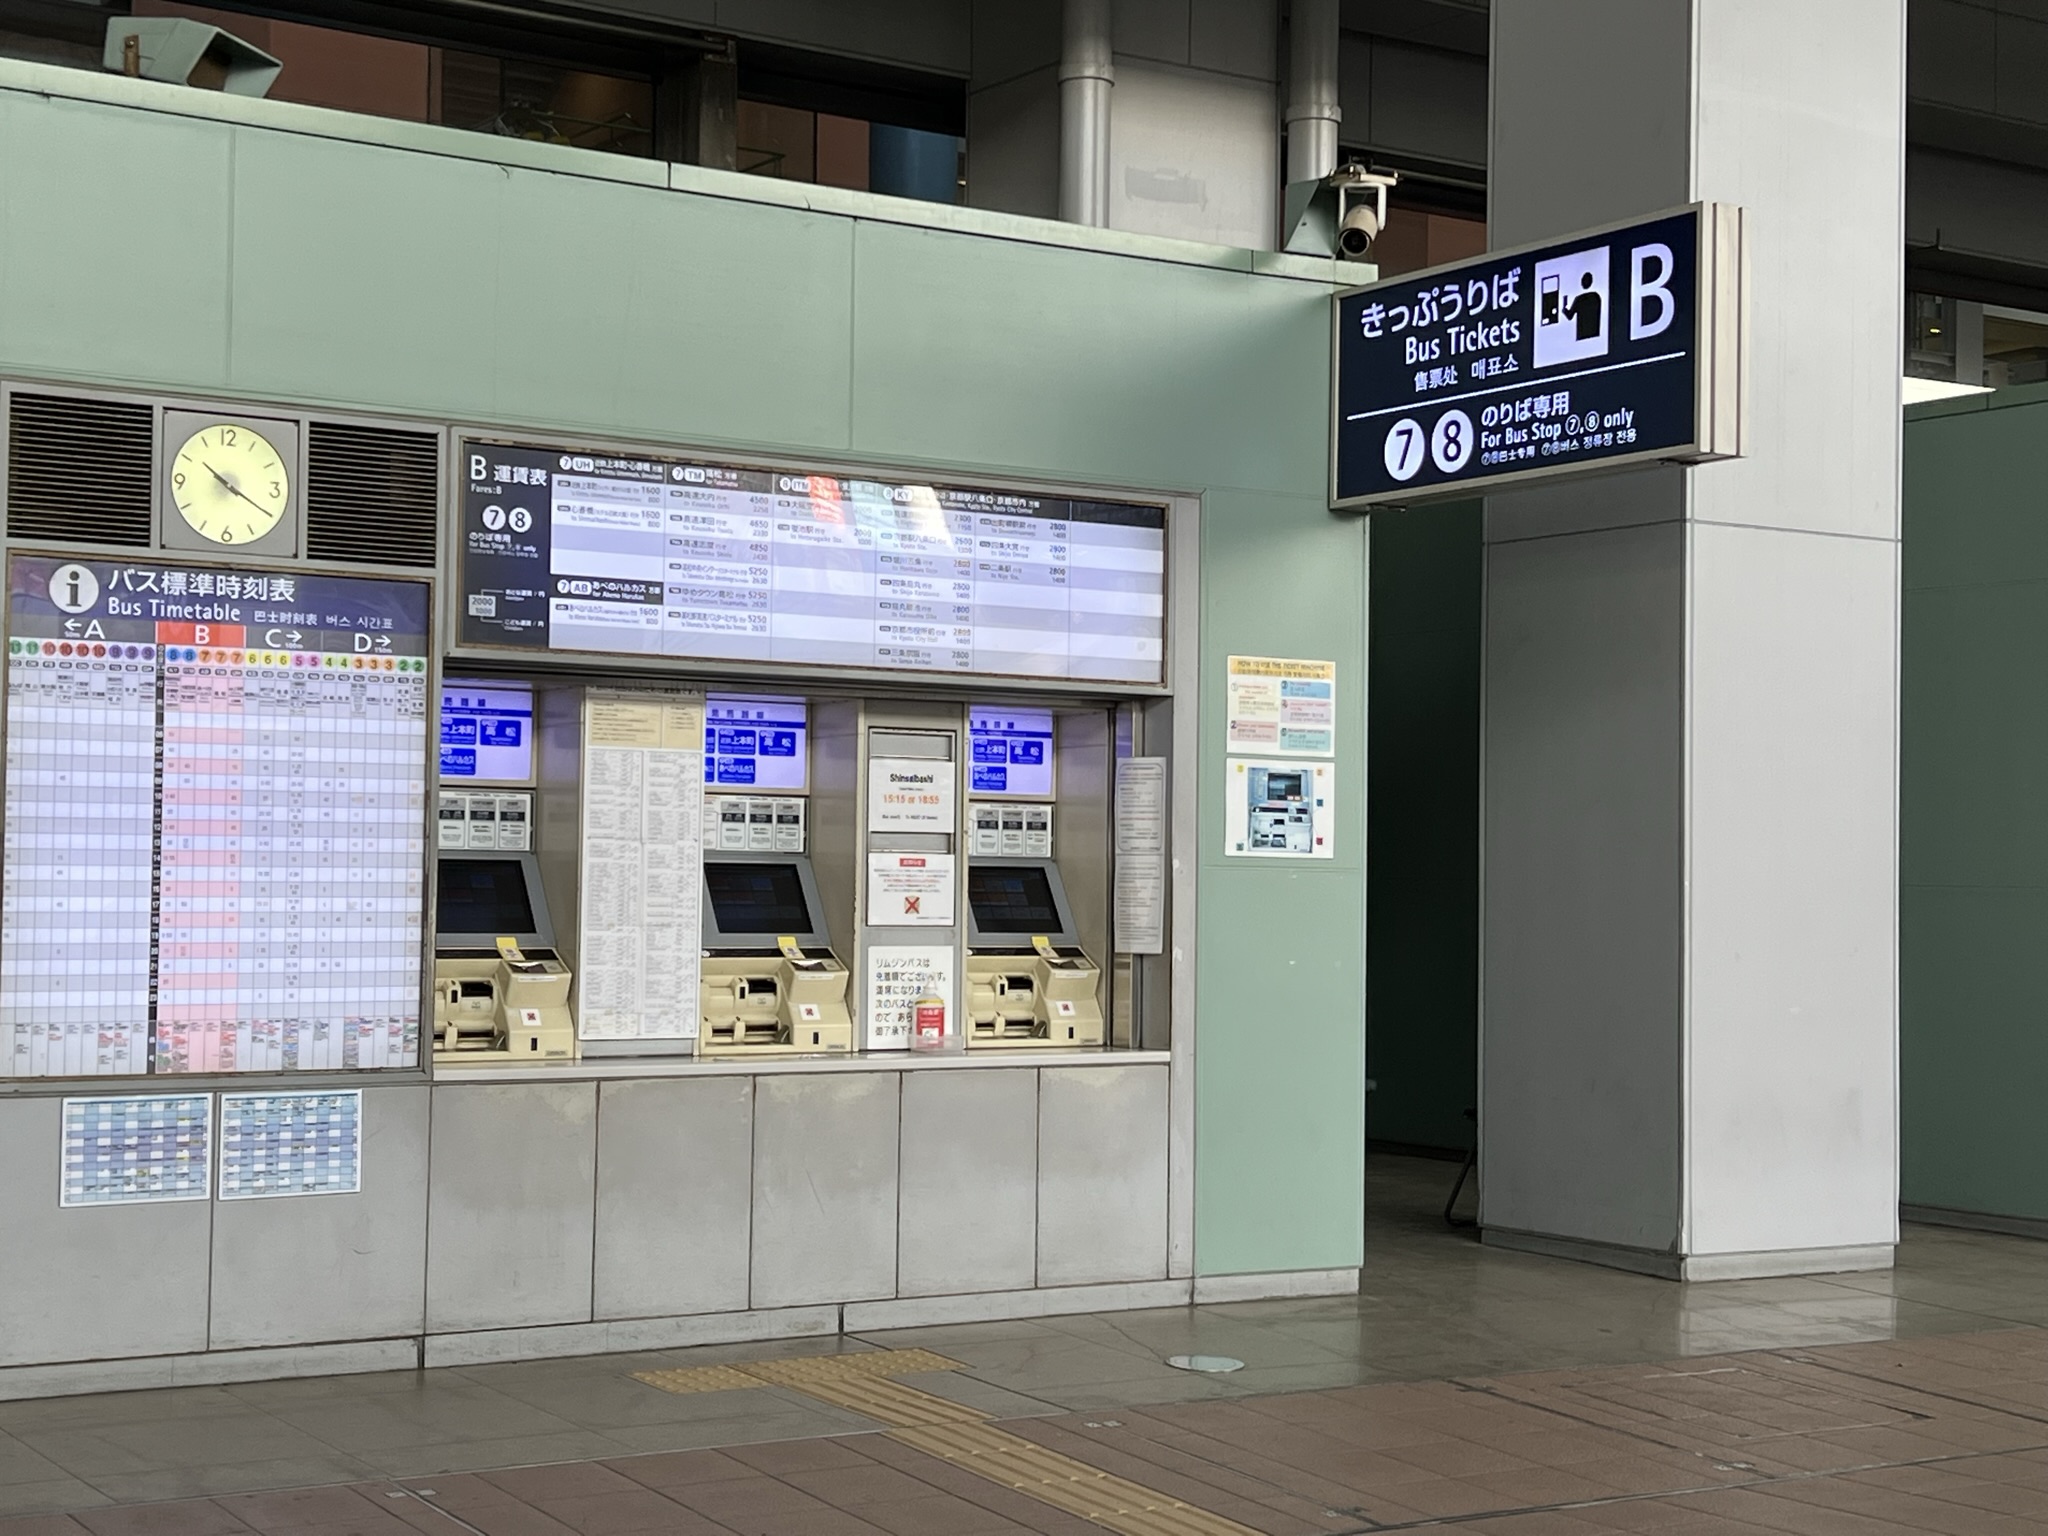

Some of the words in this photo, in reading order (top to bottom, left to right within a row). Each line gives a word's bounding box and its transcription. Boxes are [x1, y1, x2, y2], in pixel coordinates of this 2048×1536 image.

[1629, 242, 1675, 341] B
[1360, 266, 1522, 338] きっぷうりば
[1405, 336, 1440, 364] Bus
[1449, 318, 1521, 355] Tickets
[1471, 357, 1519, 380] 매표소
[1481, 390, 1570, 427] のりば専用
[220, 428, 237, 447] 12
[1481, 431, 1502, 449] For
[1505, 427, 1528, 445] Bus
[1531, 422, 1562, 441] Stop
[1603, 407, 1634, 428] only
[470, 454, 487, 481] B
[575, 460, 591, 469] UH
[174, 472, 186, 490] 9
[493, 464, 548, 487] 運賃表
[688, 470, 702, 480] TM
[268, 481, 281, 499] 3
[897, 489, 909, 498] KY
[221, 525, 233, 542] 6
[107, 568, 296, 604] バス標準時刻表
[573, 583, 588, 593] AB
[107, 597, 142, 618] Bus
[147, 598, 242, 622] Timetable
[471, 597, 493, 606] 2000
[83, 618, 106, 640] A
[325, 613, 352, 628] 버스
[356, 613, 394, 631] 시간표
[194, 625, 210, 645] B
[264, 628, 284, 649] C
[353, 633, 373, 653] D
[876, 957, 931, 969] リムジンバスは
